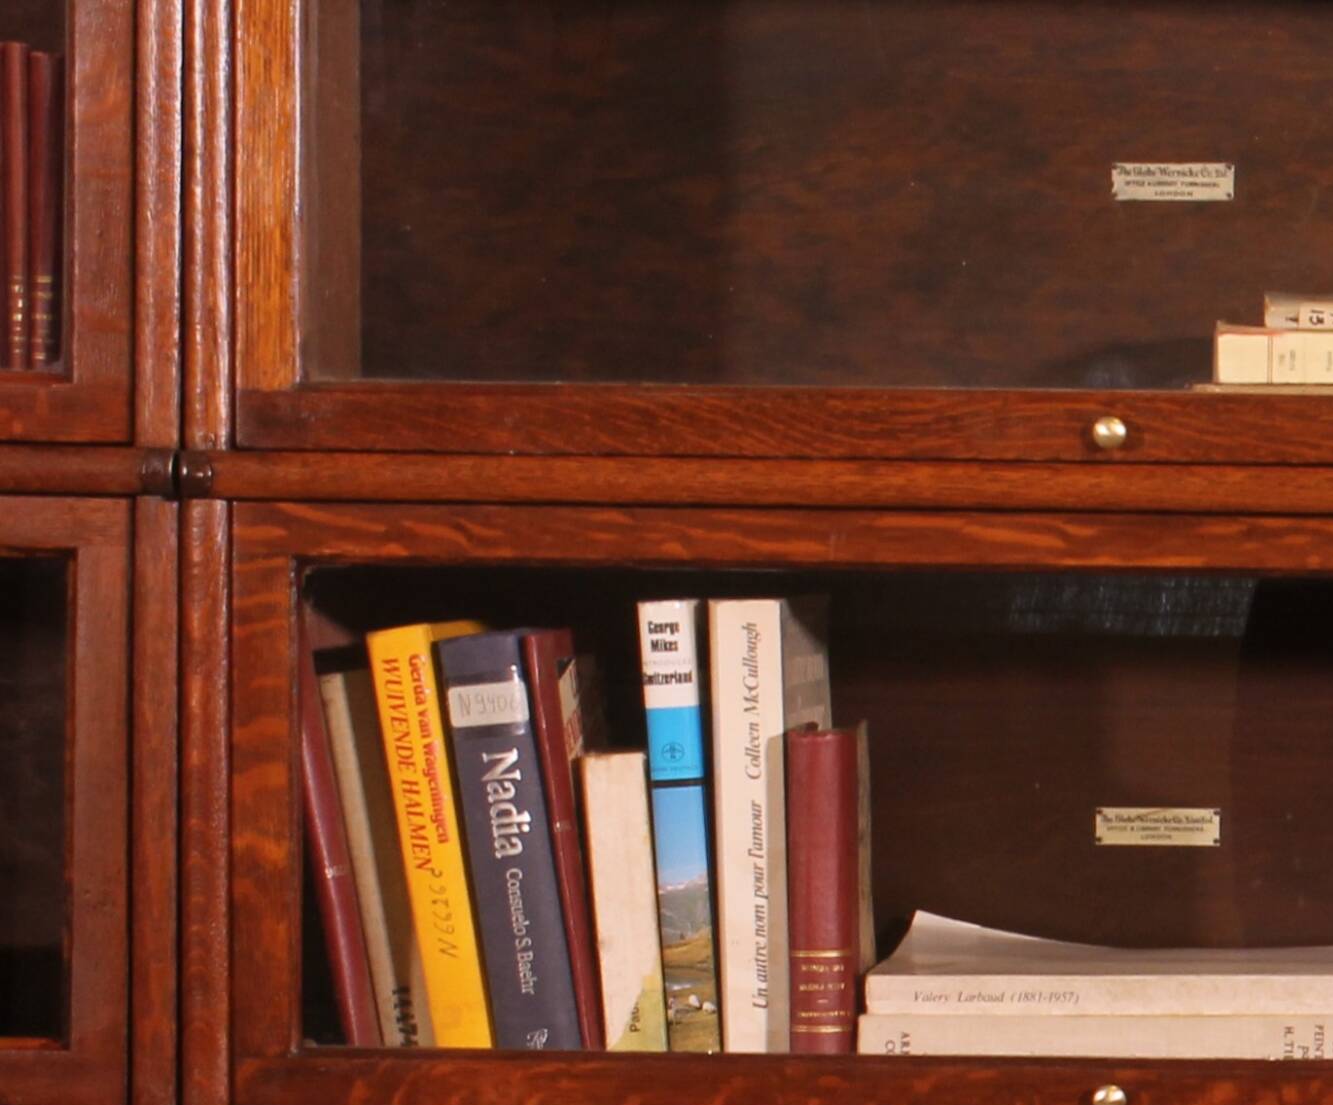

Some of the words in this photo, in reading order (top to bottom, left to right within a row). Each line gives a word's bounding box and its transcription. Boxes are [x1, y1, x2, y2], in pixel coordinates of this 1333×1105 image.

[647, 620, 680, 635] George
[651, 639, 679, 652] Mikes
[742, 621, 762, 715] McCullough
[418, 711, 433, 740] van
[382, 659, 416, 775] WUIVENDE
[401, 779, 434, 871] HALMEN
[744, 722, 761, 781] Colleen
[422, 741, 449, 844] Wageningen
[482, 747, 531, 859] Nadia
[753, 861, 769, 903] pour
[506, 868, 526, 937] Consuelo
[516, 949, 536, 995] Baehr
[754, 904, 767, 941] nom
[755, 942, 768, 987] autre
[751, 988, 768, 1010] Un
